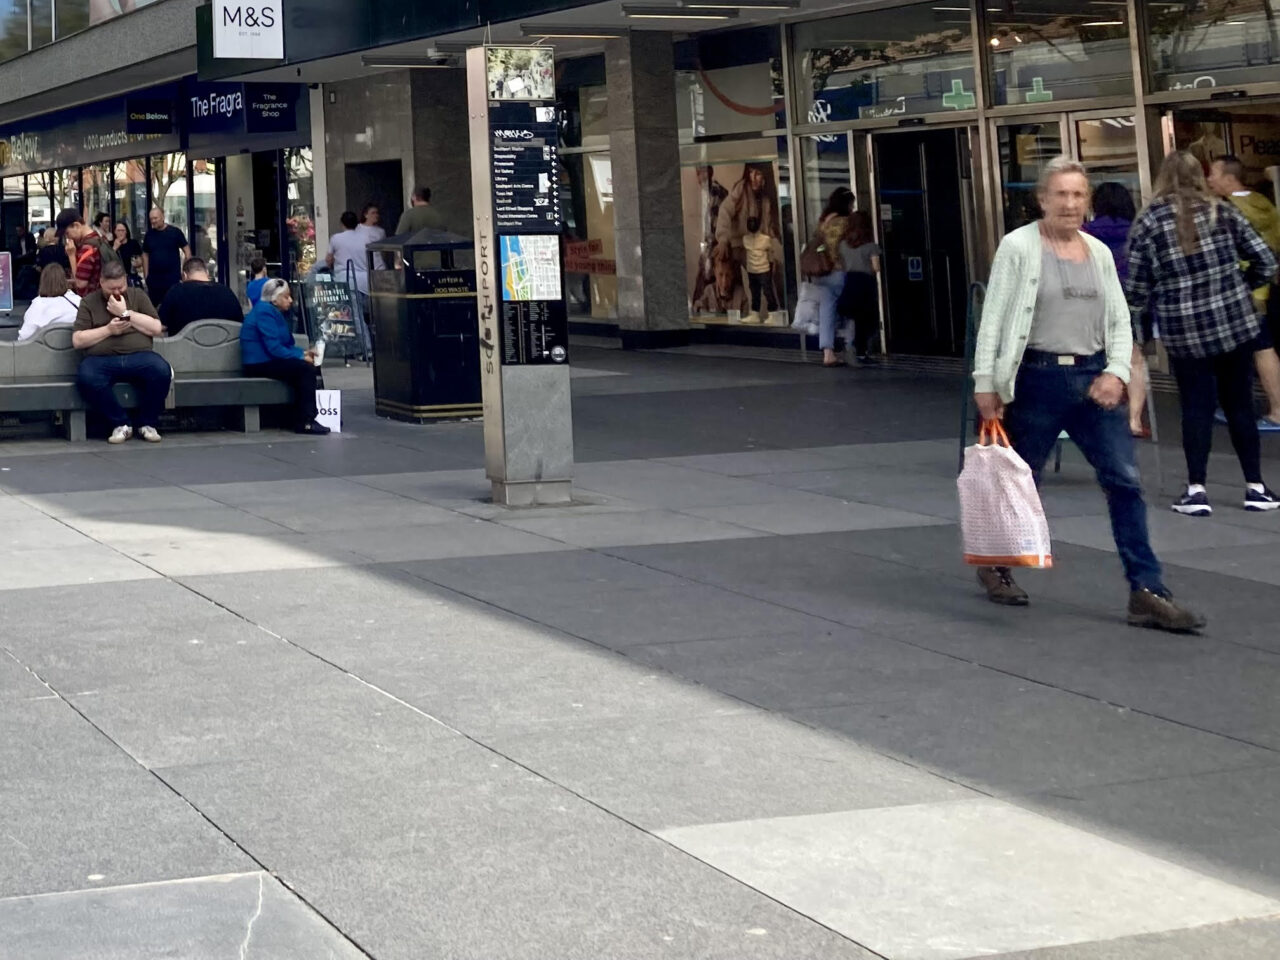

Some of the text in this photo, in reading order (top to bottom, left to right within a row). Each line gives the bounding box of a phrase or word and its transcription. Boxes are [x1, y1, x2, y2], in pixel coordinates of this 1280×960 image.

[223, 5, 275, 28] M&S
[263, 93, 277, 101] The
[191, 91, 242, 118] The Fragra
[252, 102, 288, 110] Fragrance
[262, 110, 280, 118] Shop
[319, 407, 338, 416] OSS
